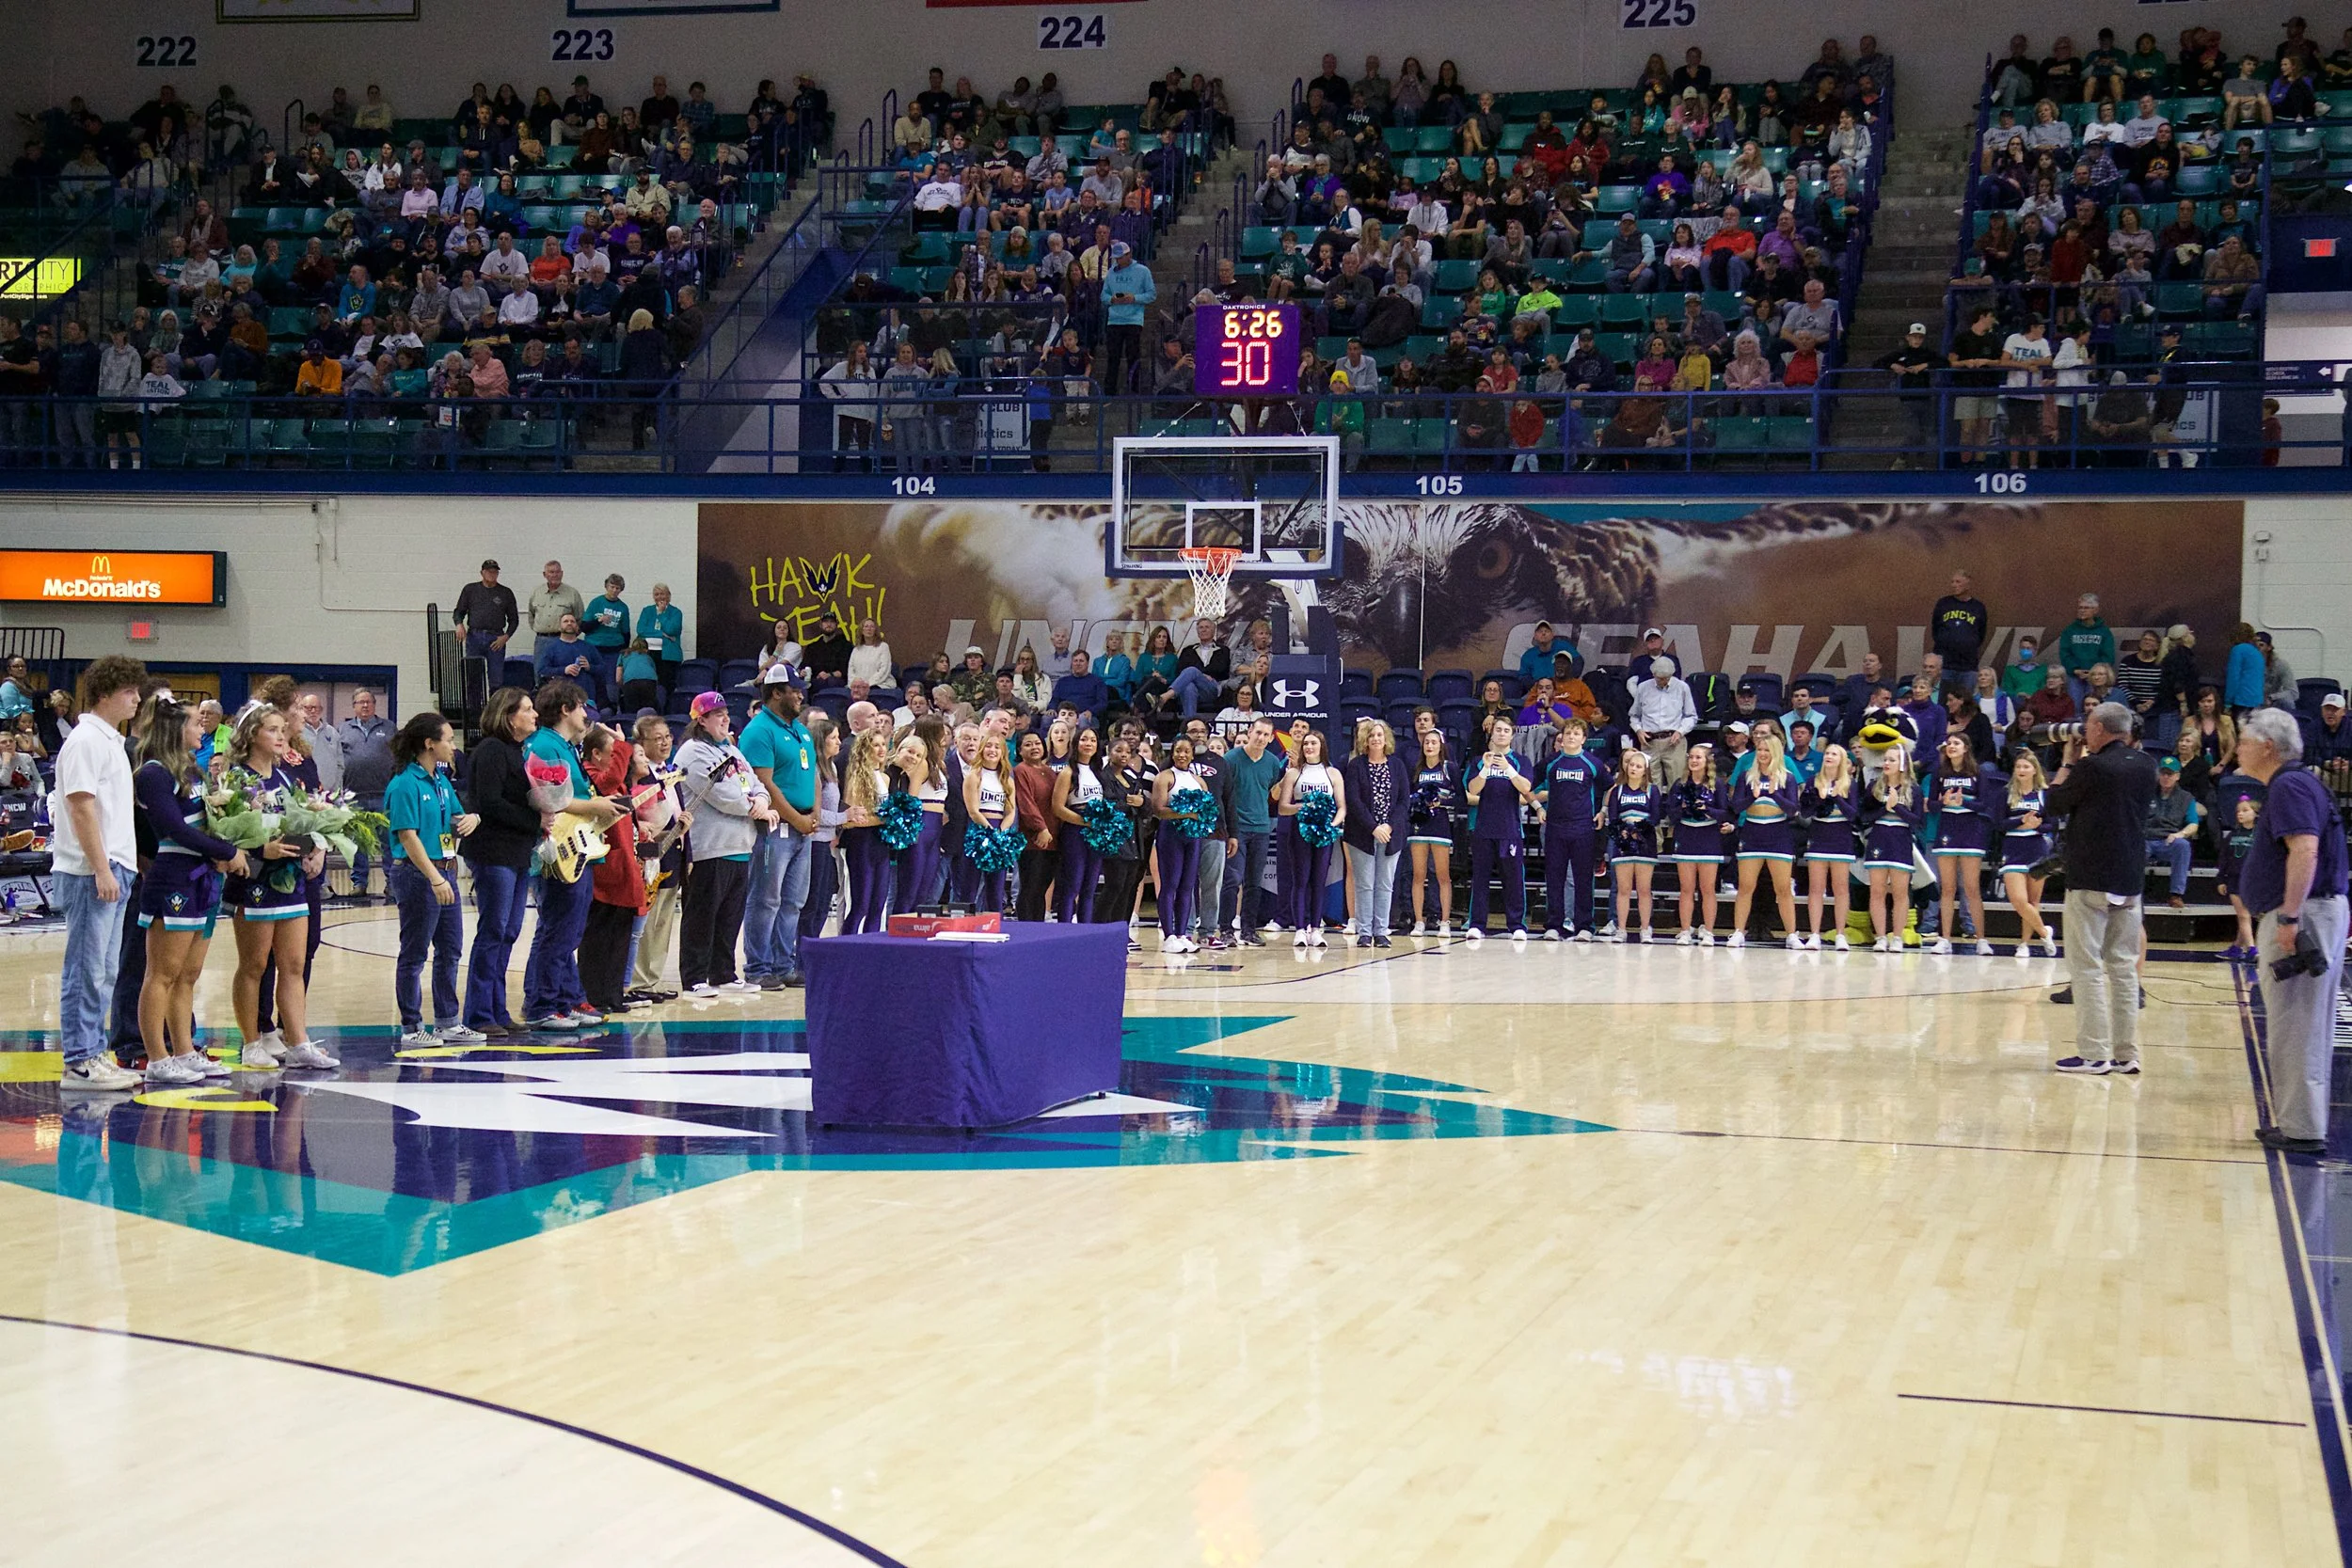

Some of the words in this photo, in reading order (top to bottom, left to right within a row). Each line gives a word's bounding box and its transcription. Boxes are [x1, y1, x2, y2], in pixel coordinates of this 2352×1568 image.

[1624, 0, 1696, 28] 225
[1040, 15, 1105, 49] 224
[137, 36, 197, 67] 222
[552, 29, 614, 61] 223
[1224, 311, 1282, 339] 6:26
[1220, 341, 1270, 387] 30
[146, 380, 170, 388] TEAL
[891, 476, 936, 496] 104
[1416, 475, 1463, 495] 105
[1975, 472, 2027, 494] 106
[43, 578, 161, 598] McDonald's
[750, 552, 875, 607] HAWK
[1943, 610, 1976, 625] UNCW
[1420, 773, 1444, 784] UNCW
[1556, 769, 1584, 782] UNCW
[1944, 778, 1972, 787] UNCW
[1301, 784, 1328, 794] UNCW
[1620, 795, 1646, 805] UNCW
